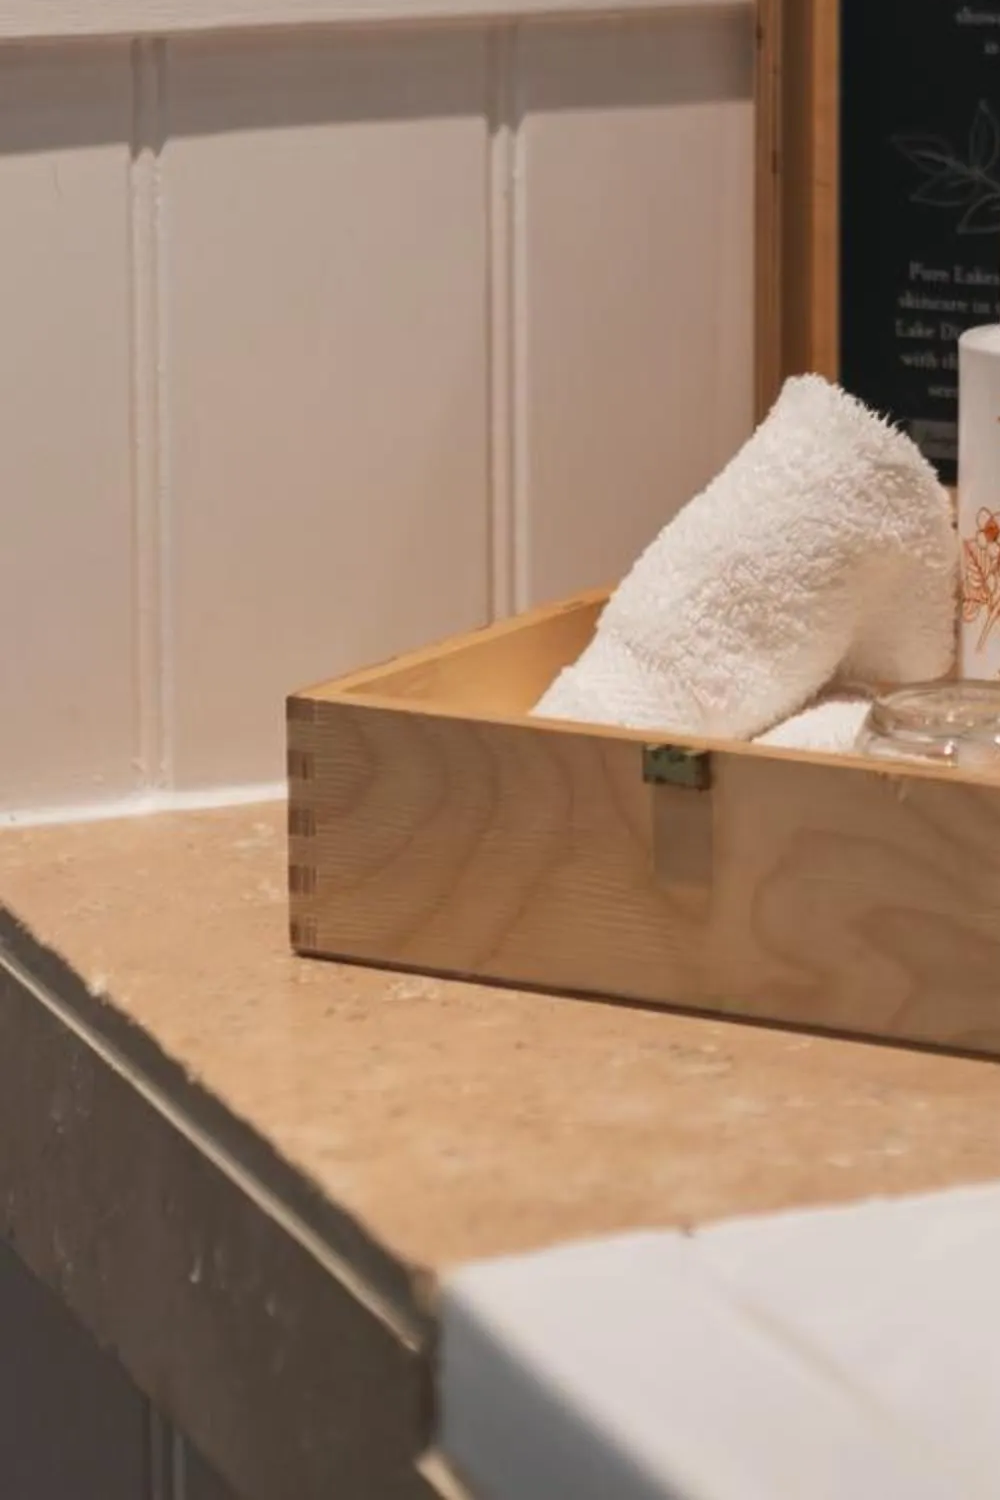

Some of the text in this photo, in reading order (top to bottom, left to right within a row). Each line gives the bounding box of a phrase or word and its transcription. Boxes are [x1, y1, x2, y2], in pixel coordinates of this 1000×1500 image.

[909, 260, 950, 283] Pure
[897, 289, 969, 314] skincare
[895, 317, 937, 339] Lake
[899, 348, 939, 371] with
